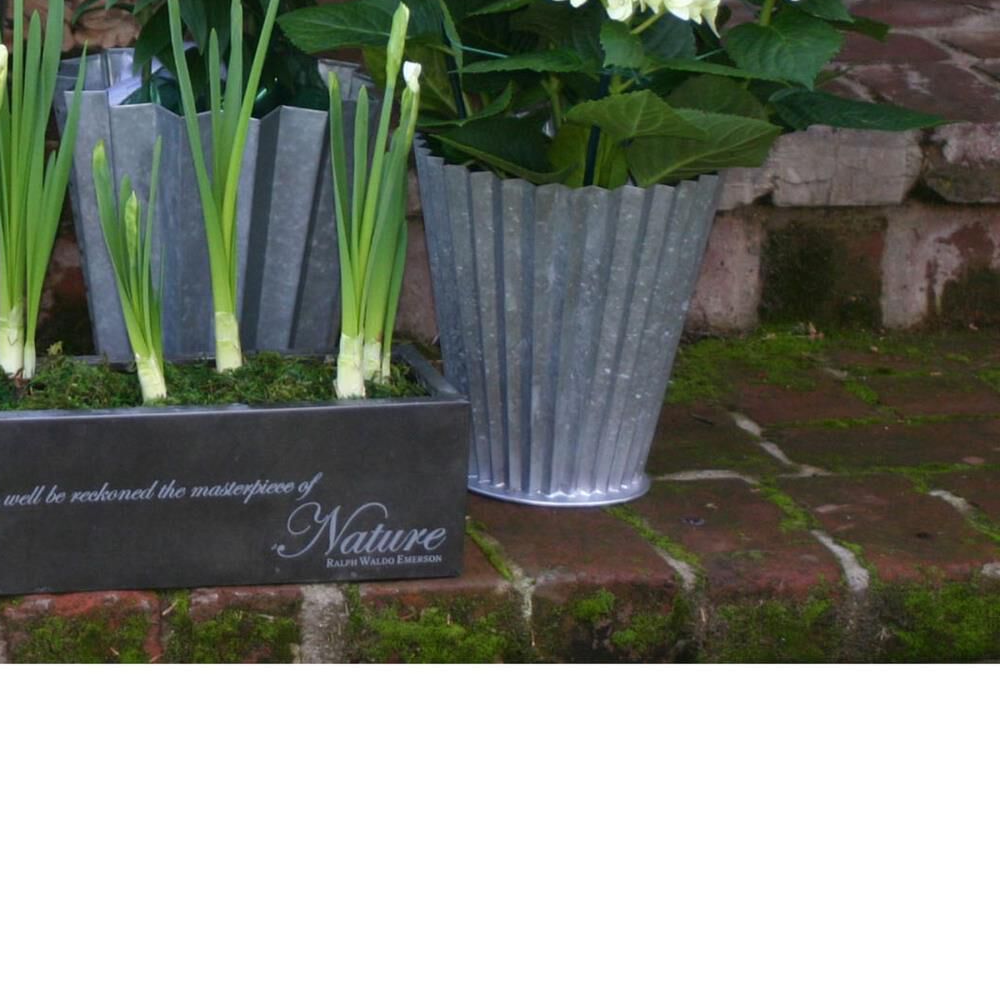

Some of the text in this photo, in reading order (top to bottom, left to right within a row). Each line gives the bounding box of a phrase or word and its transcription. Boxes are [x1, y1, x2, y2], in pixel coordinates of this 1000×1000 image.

[3, 485, 46, 507] well
[45, 484, 67, 504] be
[70, 480, 158, 503] reckoned
[157, 479, 187, 499] the
[189, 479, 296, 504] masterpiece
[295, 471, 324, 501] of
[276, 501, 448, 558] Nature
